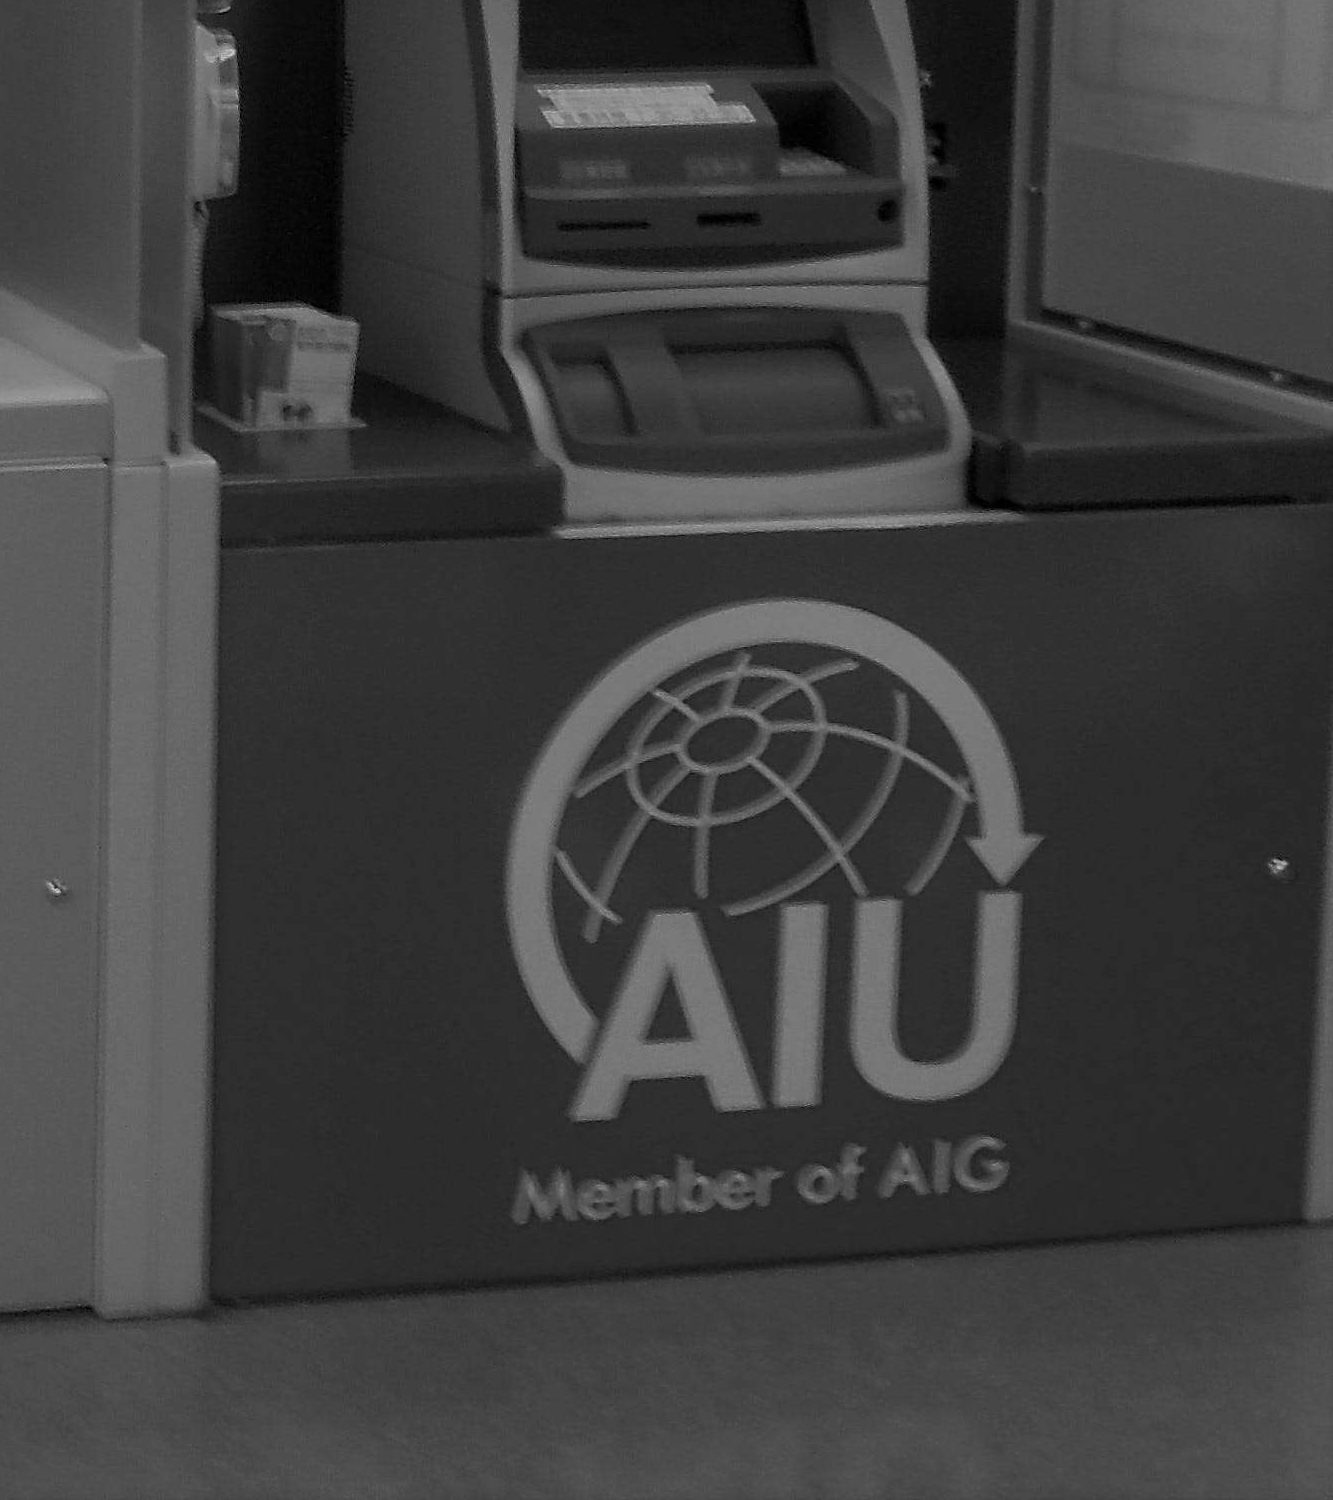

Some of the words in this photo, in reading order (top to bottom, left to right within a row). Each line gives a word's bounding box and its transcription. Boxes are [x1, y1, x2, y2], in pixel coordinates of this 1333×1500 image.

[568, 889, 1023, 1122] AIU
[512, 1156, 784, 1225] Member
[797, 1143, 866, 1205] of
[880, 1134, 1010, 1198] AIG
